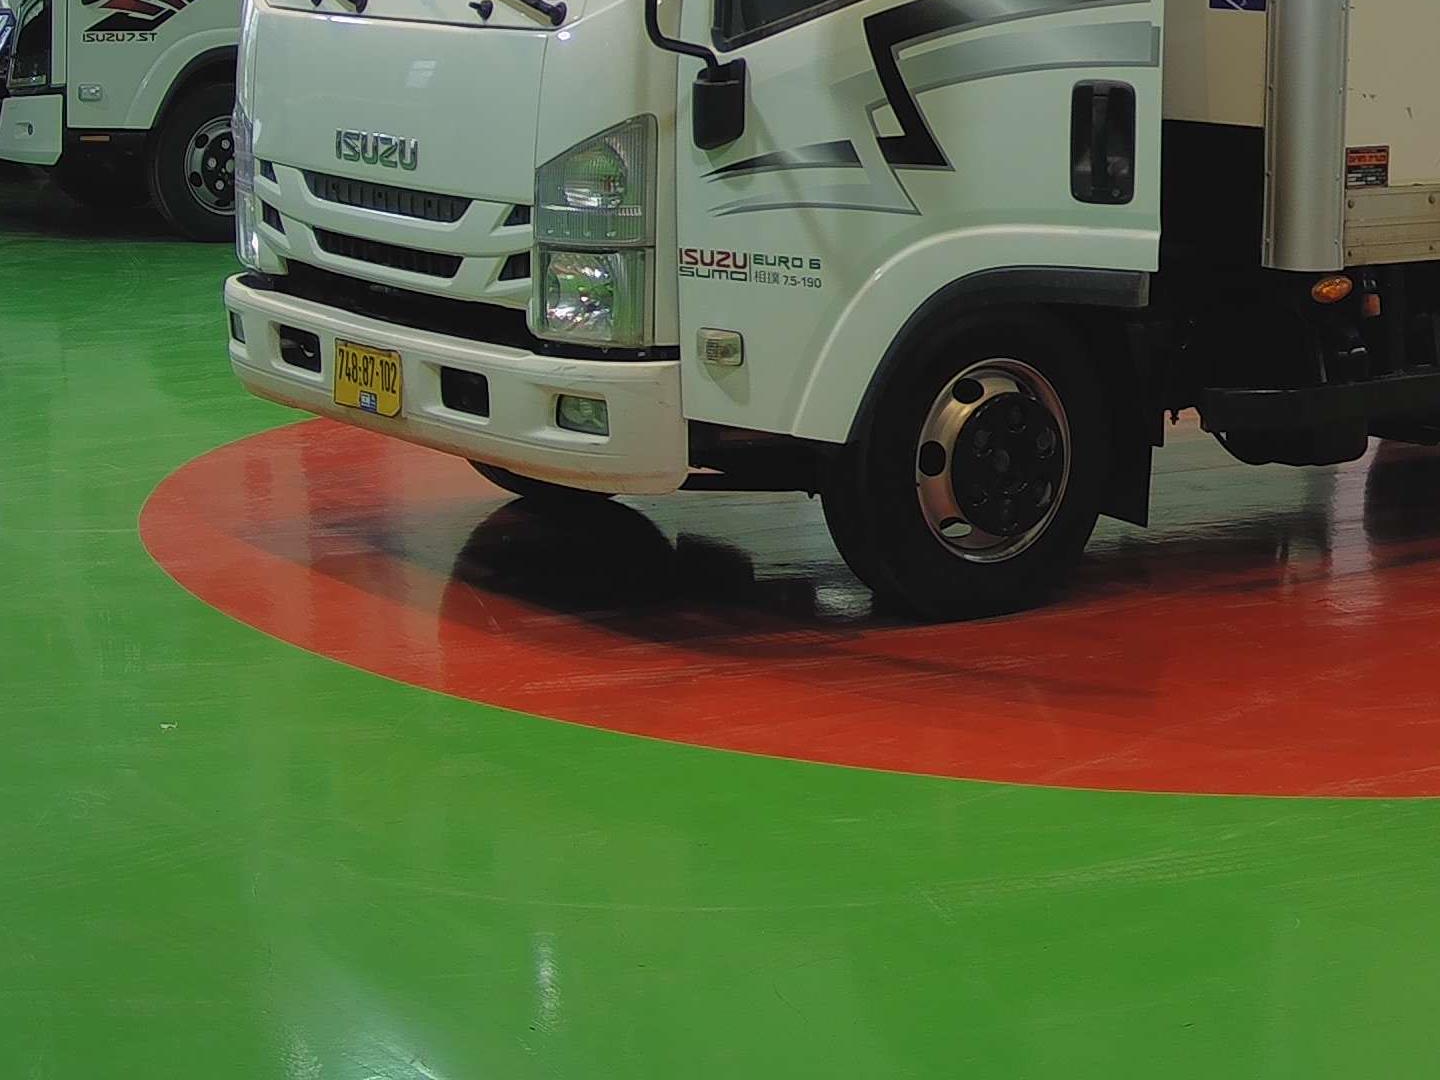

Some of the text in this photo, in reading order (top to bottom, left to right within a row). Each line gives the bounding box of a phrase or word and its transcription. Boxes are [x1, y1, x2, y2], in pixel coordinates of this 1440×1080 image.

[335, 127, 419, 171] ISUZU
[678, 247, 822, 270] ISUZU EURO 6
[678, 265, 748, 282] SUMO
